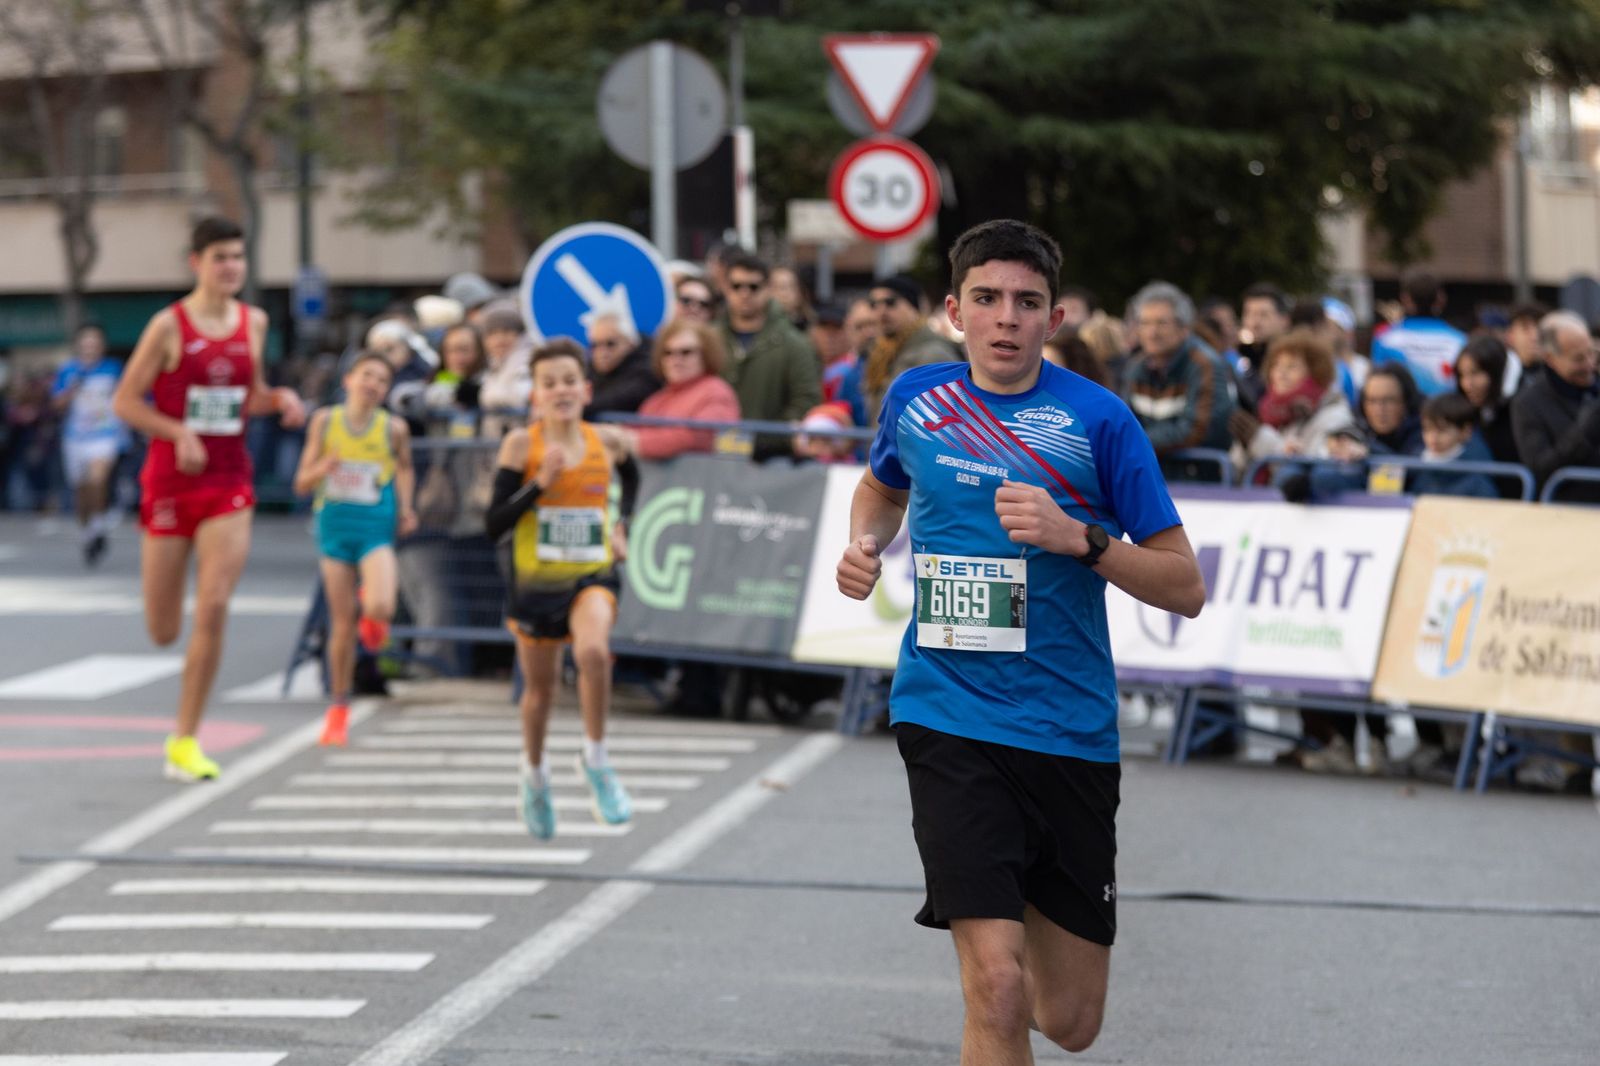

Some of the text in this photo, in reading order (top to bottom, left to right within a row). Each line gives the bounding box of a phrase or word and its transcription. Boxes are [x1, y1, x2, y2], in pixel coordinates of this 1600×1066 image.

[856, 173, 912, 210] 30
[936, 454, 964, 469] CAMPEONATO
[971, 462, 987, 473] ESPAÑA
[939, 560, 1013, 579] SETEL
[930, 579, 990, 619] 6169
[1478, 636, 1505, 673] de
